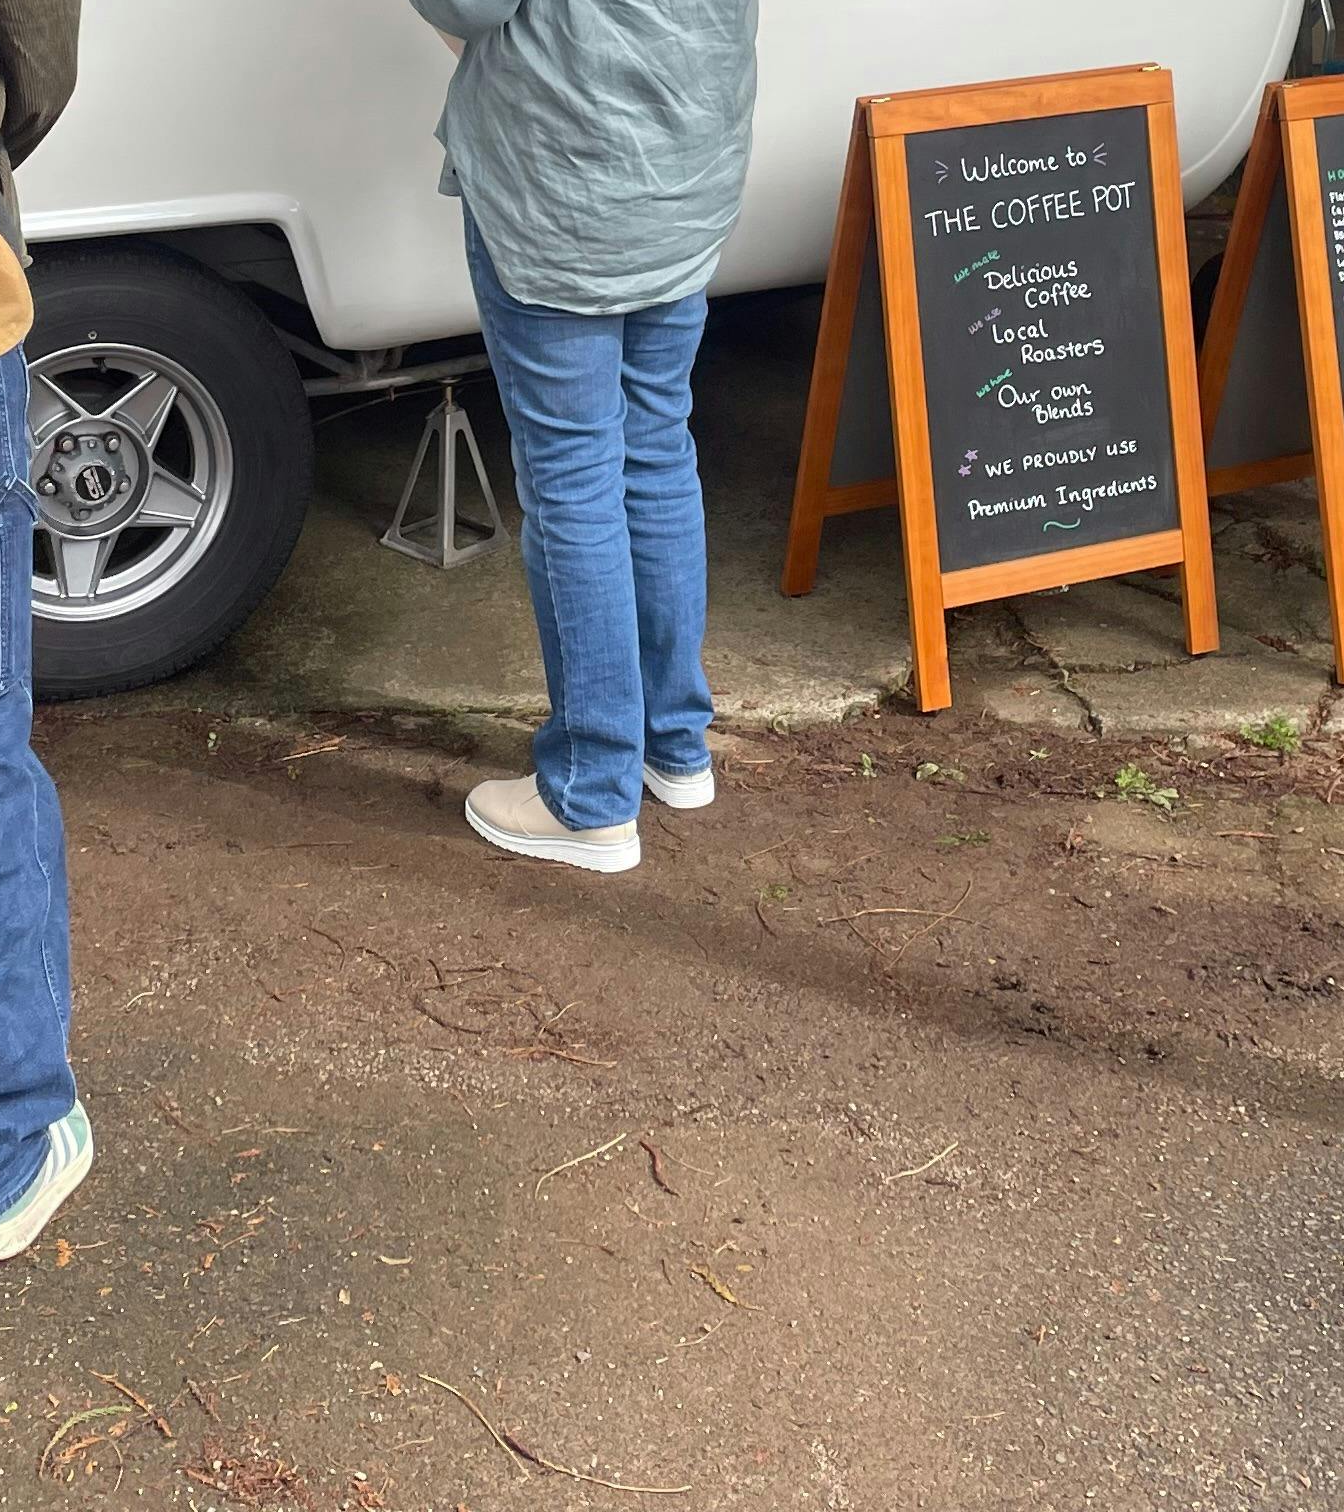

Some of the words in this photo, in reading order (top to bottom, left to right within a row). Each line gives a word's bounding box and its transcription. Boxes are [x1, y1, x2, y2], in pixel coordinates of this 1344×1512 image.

[960, 153, 1059, 182] Welcome
[1065, 145, 1087, 167] to
[924, 205, 981, 237] THE
[991, 189, 1085, 229] COFFEE
[1092, 181, 1136, 213] POT
[984, 260, 1078, 290] Delicious
[1024, 282, 1092, 308] Coffee
[992, 318, 1049, 344] Local
[1021, 338, 1106, 365] Roasters
[998, 384, 1041, 408] Our
[1050, 383, 1092, 400] own
[1031, 399, 1094, 425] Blends
[984, 459, 1014, 478] WE
[1022, 446, 1097, 471] PROUDLY
[1106, 440, 1139, 456] USE
[967, 493, 1047, 520] Premium
[1055, 474, 1158, 512] Ingredients
